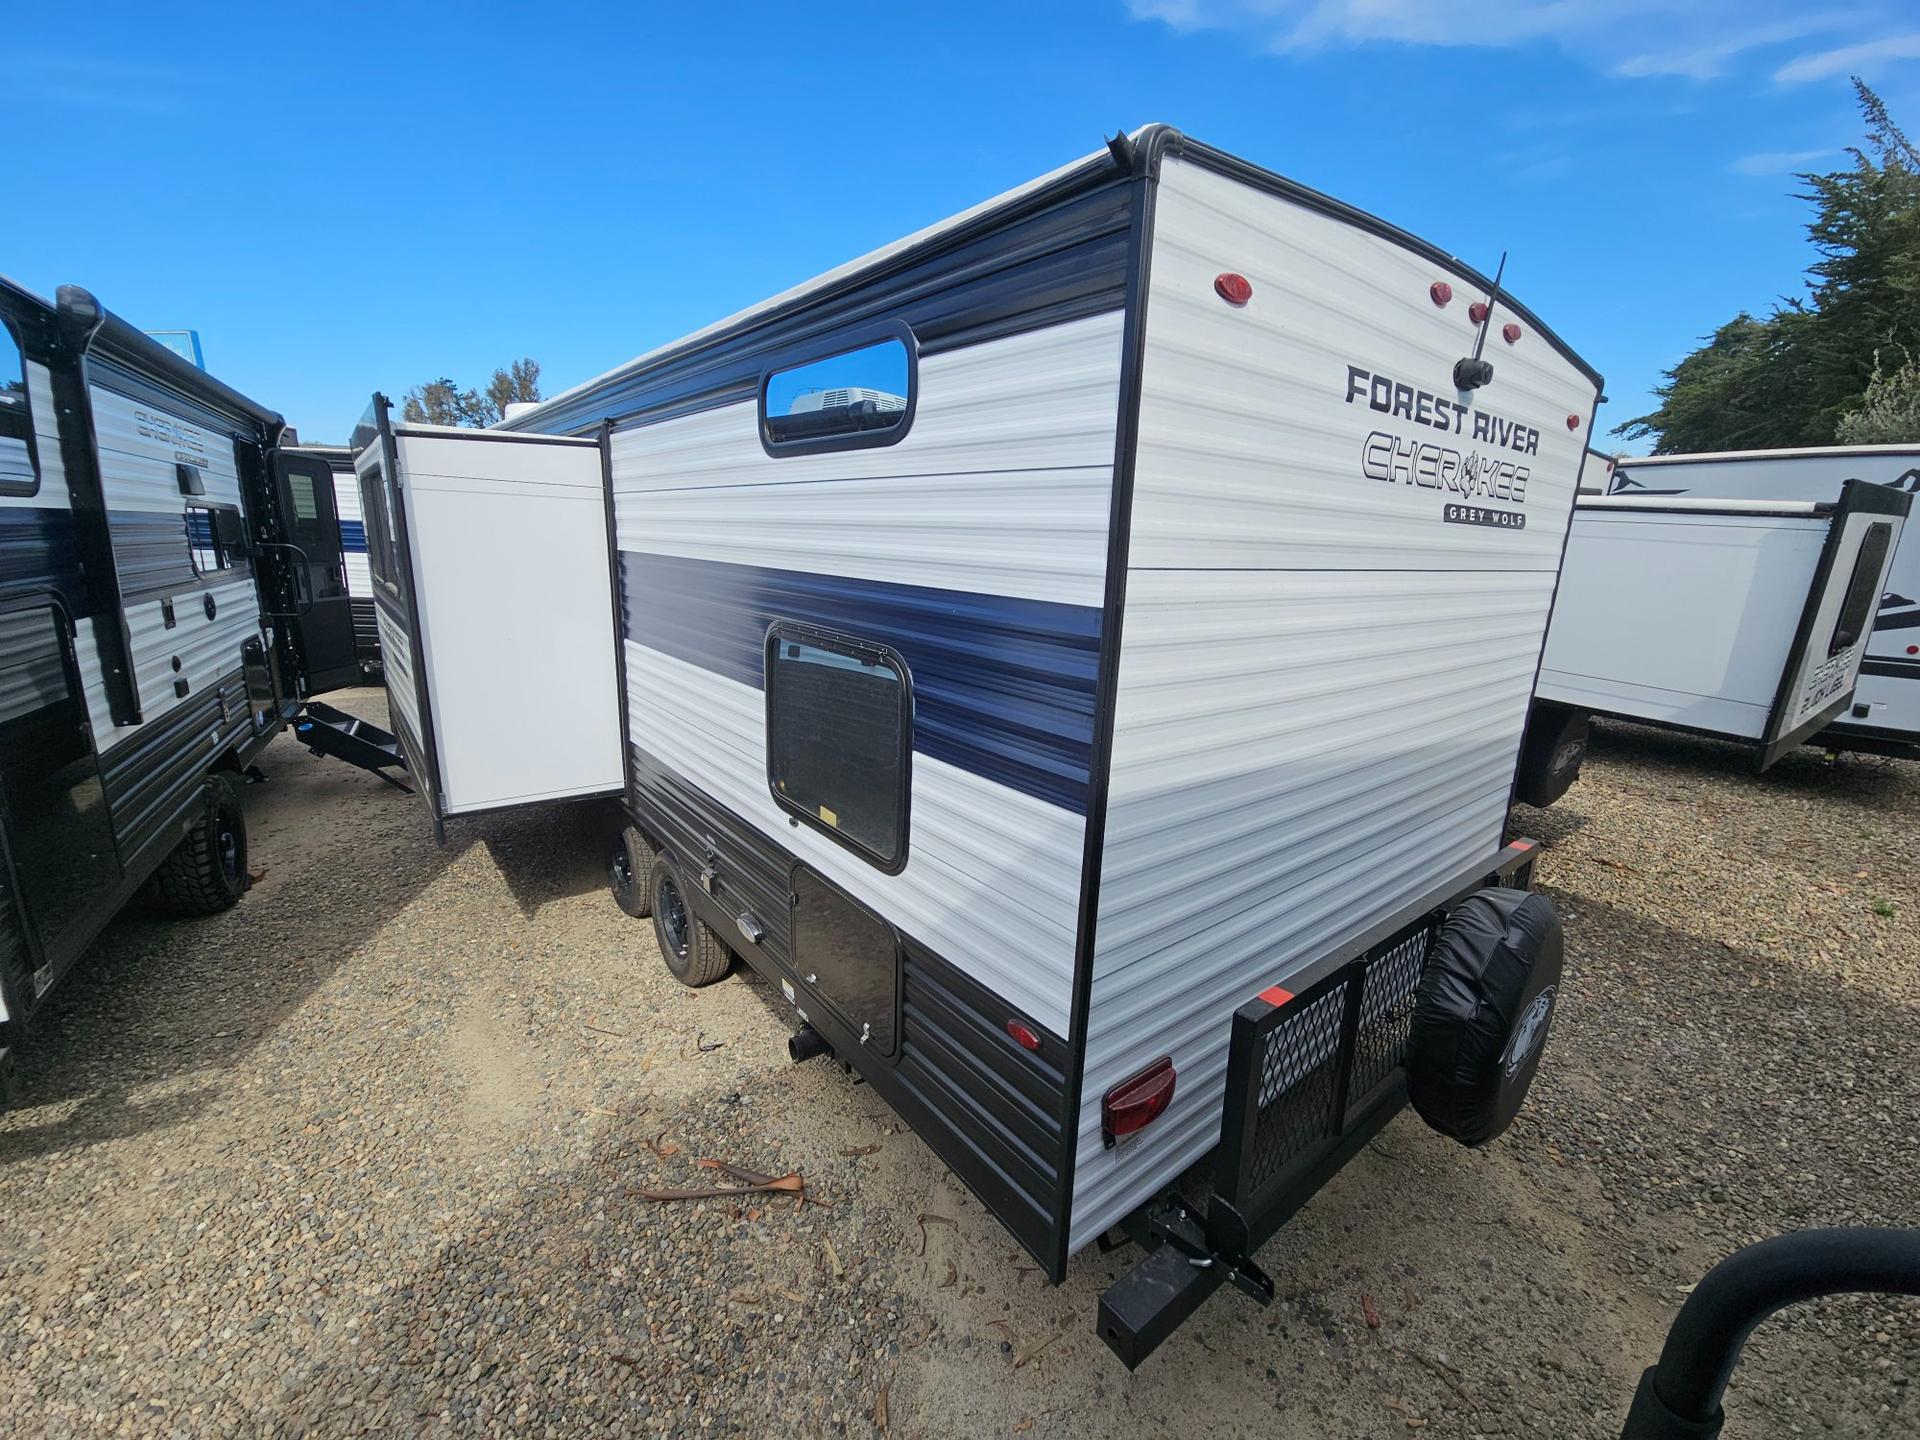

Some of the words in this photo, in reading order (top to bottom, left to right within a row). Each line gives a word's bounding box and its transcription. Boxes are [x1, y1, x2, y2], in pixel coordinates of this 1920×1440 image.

[1345, 365, 1468, 434] FOREST
[1472, 410, 1540, 456] RIVER
[1362, 430, 1530, 503] CHEROKEE
[1449, 506, 1485, 522] GREY
[1492, 512, 1523, 526] WOLF
